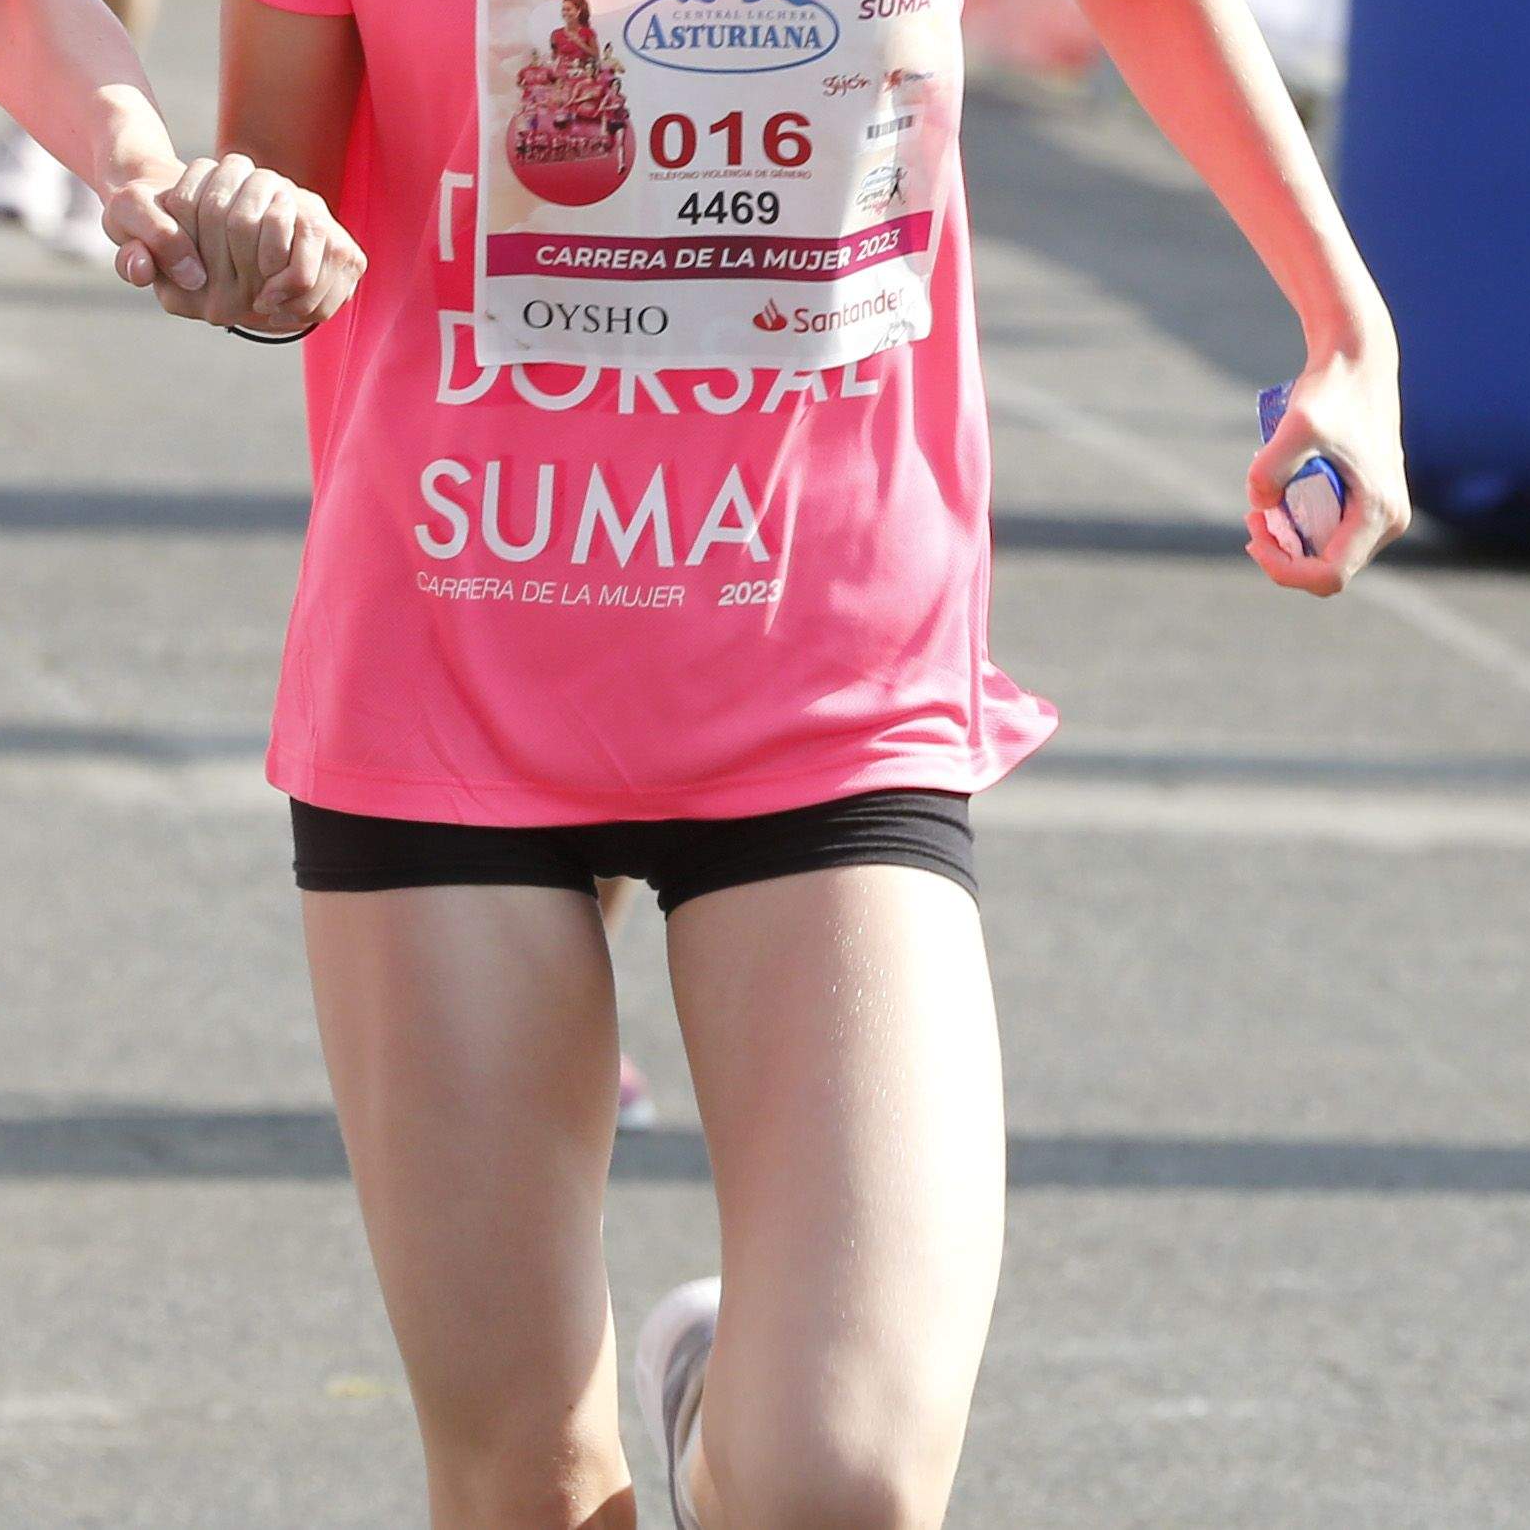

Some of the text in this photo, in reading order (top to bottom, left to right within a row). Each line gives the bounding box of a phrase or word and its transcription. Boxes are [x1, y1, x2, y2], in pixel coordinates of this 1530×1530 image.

[638, 14, 823, 51] ASTURIANA
[672, 10, 742, 22] CENTRAL
[648, 110, 814, 170] 016
[678, 190, 781, 226] 4469
[534, 228, 902, 271] CARRERA DE LA MUJER 2023
[522, 287, 904, 336] OYSHO Santander
[413, 457, 771, 569] SUMA
[415, 571, 784, 609] CARRERA DE LA MUJER 2023
